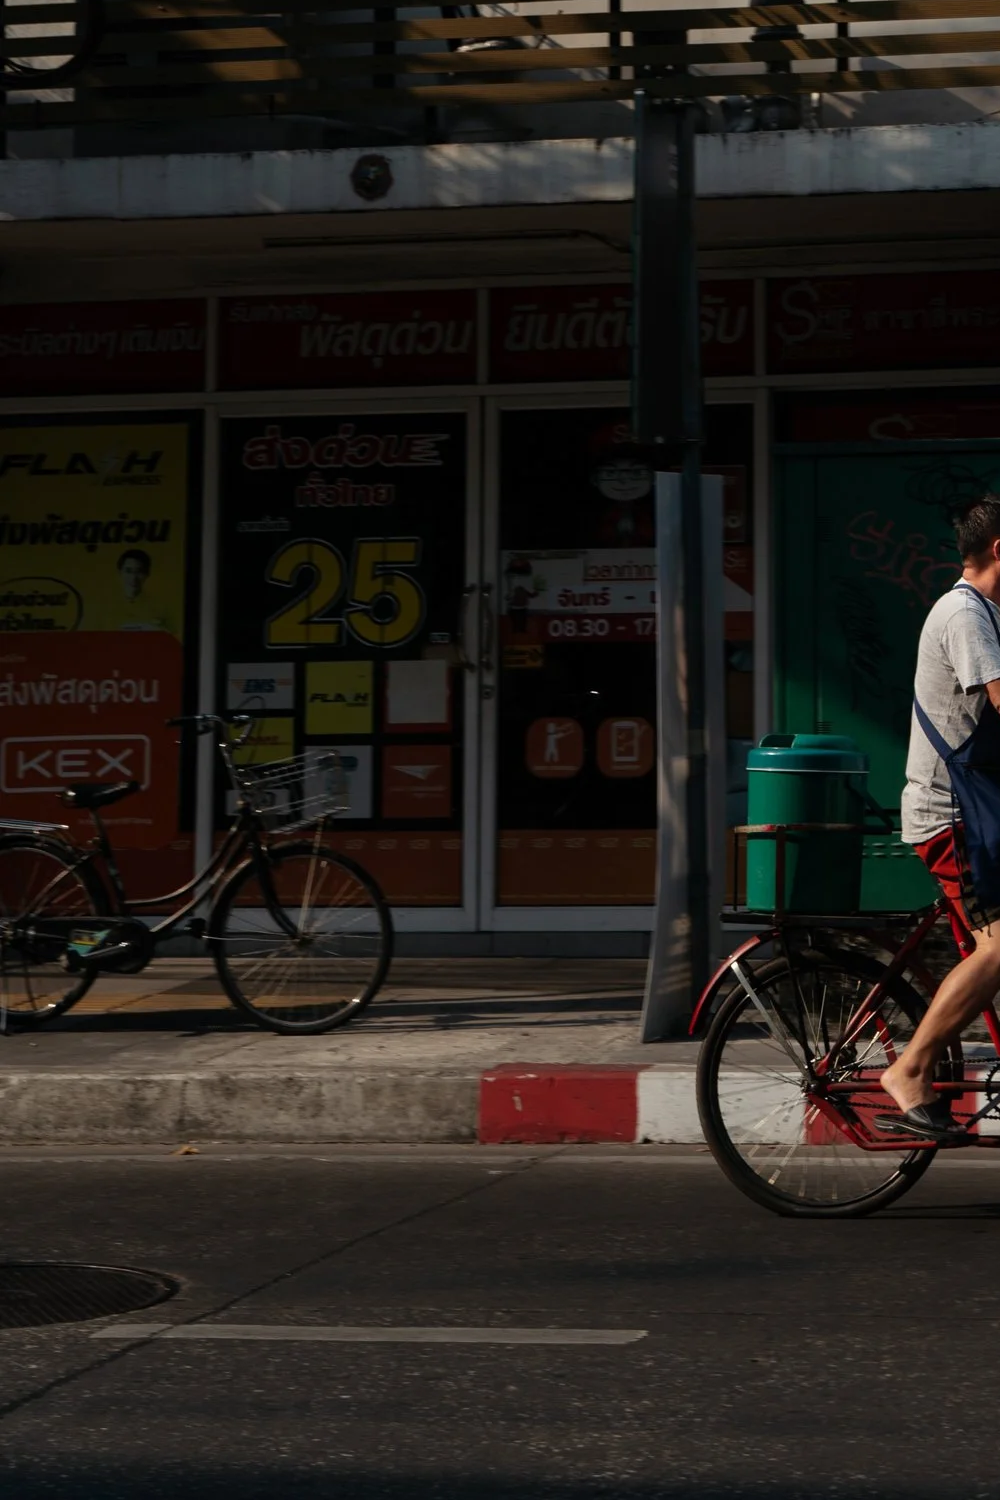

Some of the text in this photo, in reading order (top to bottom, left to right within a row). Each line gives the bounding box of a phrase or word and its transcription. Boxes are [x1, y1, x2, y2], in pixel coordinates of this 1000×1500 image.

[299, 309, 474, 369] พัสดุด่วน
[503, 295, 748, 352] ยินดีต้รับ
[243, 423, 447, 469] ส่งด่วน
[264, 535, 427, 649] 25
[548, 618, 610, 638] 08.30
[16, 747, 136, 780] KEX
